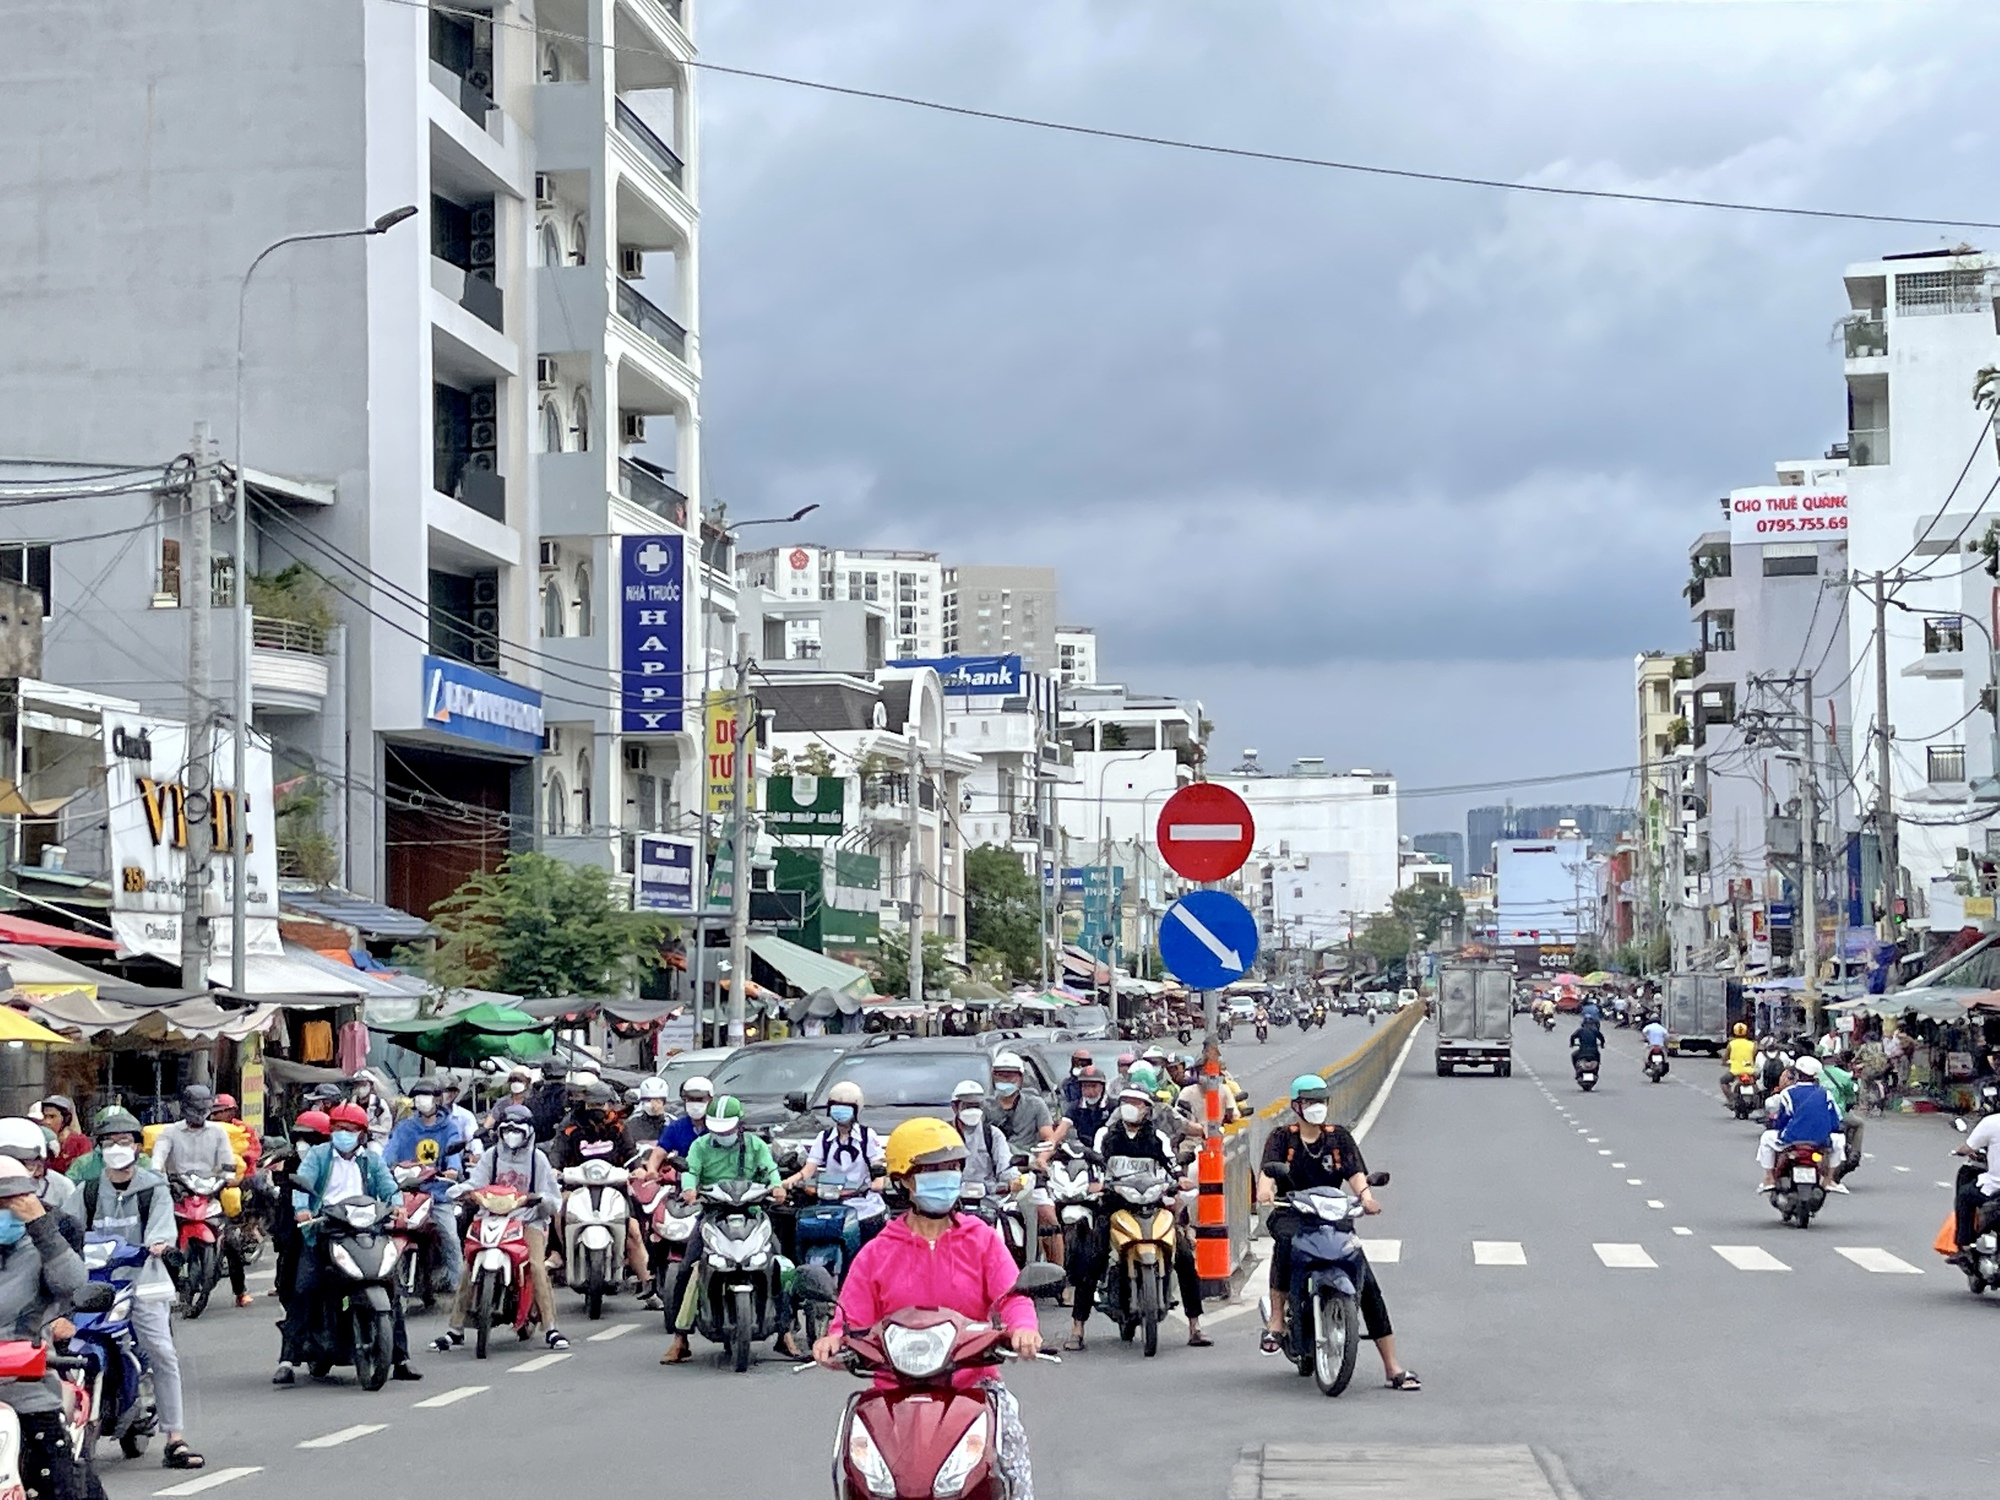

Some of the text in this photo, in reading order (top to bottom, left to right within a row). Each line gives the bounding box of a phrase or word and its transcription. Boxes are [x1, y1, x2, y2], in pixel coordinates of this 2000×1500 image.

[1734, 499, 1761, 513] CHO
[1766, 495, 1798, 512] THUÊ
[1756, 516, 1848, 532] 0795.755.69
[626, 578, 680, 602] NHÀ THUỐC
[638, 610, 669, 728] HAPPY
